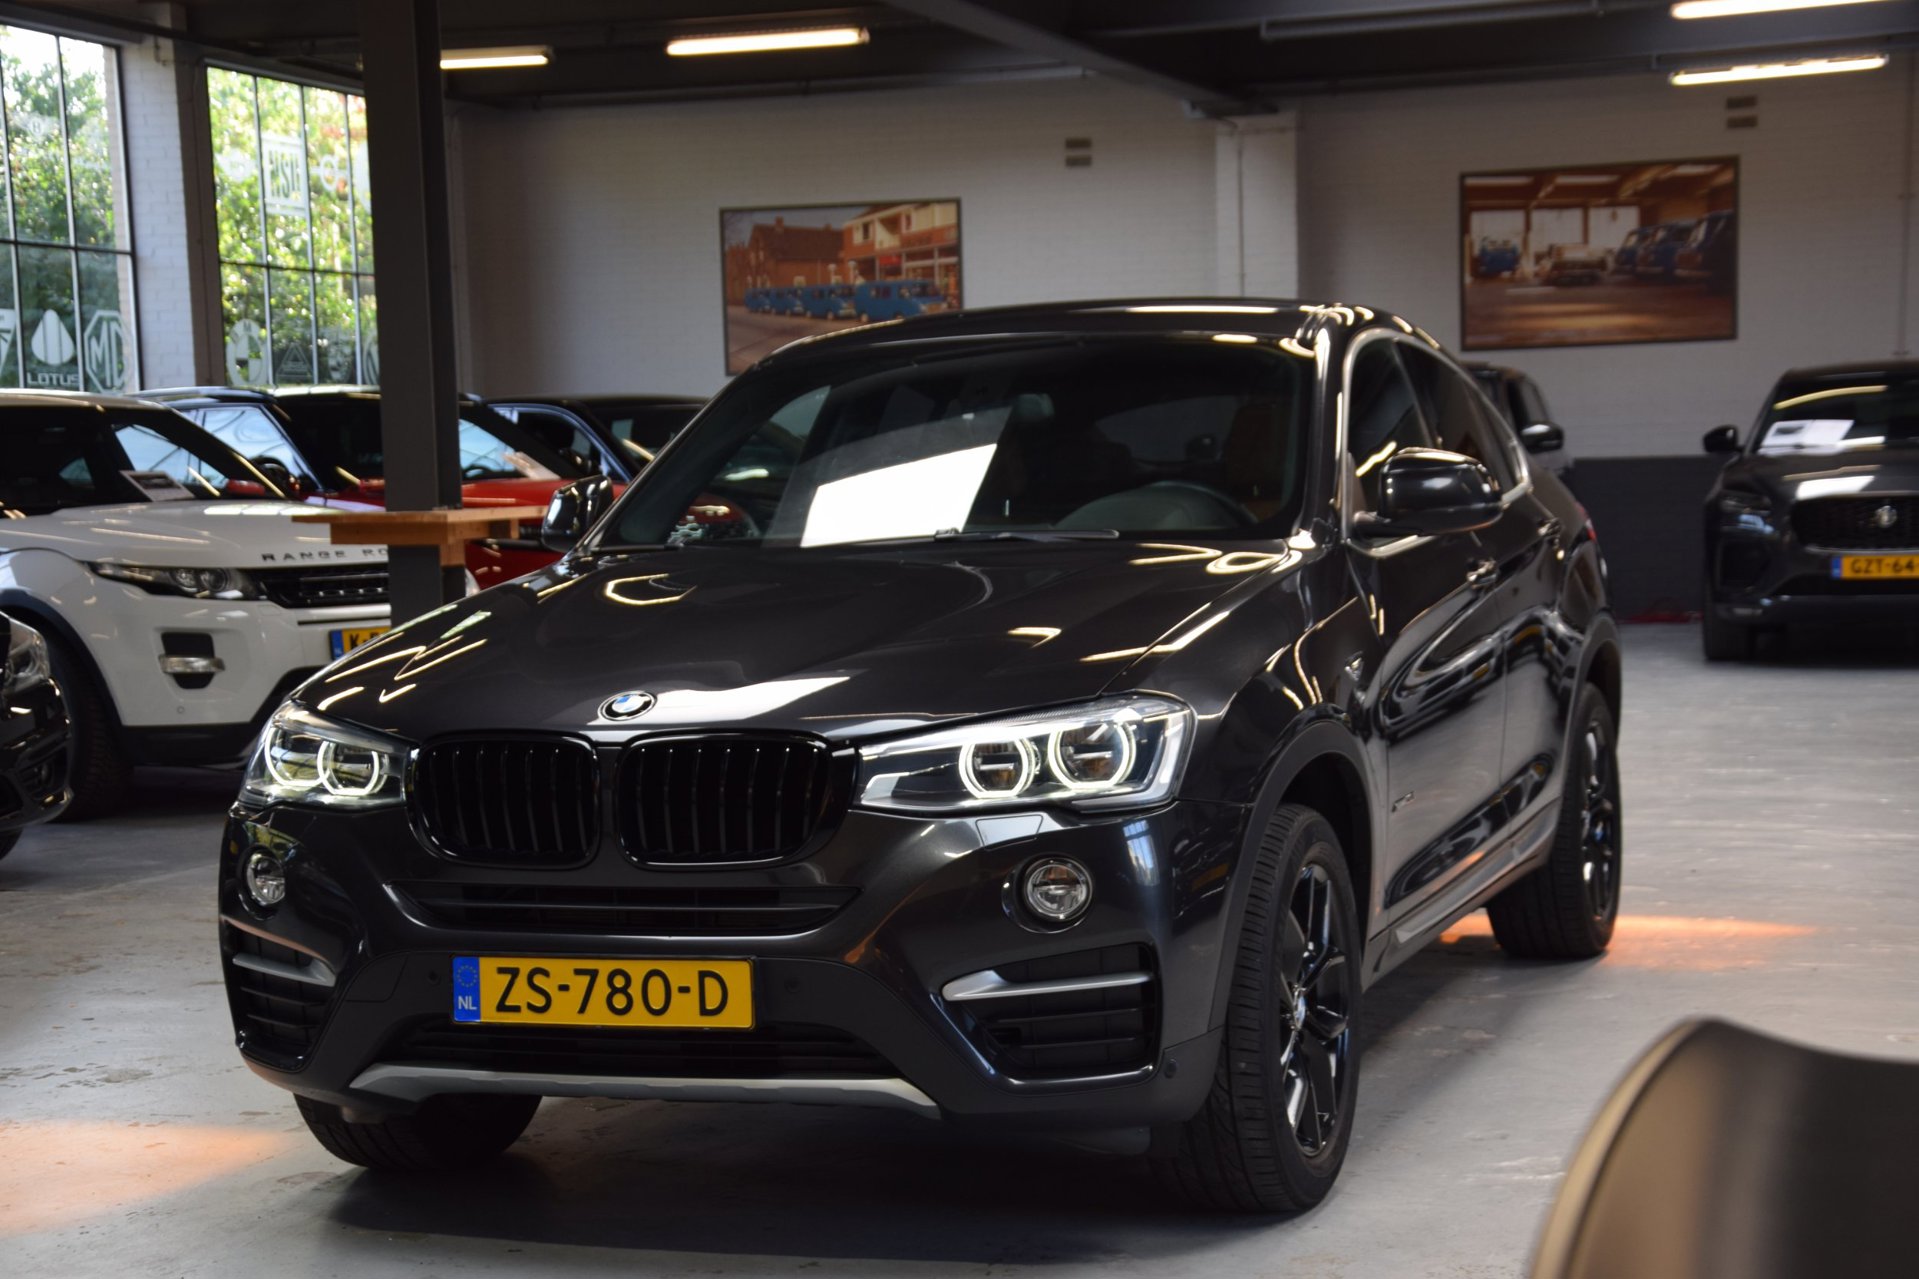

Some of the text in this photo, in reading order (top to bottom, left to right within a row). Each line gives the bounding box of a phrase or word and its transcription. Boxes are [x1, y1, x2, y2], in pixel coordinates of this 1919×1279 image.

[27, 372, 81, 385] LOTUS
[261, 549, 346, 562] RANGE
[495, 966, 729, 1017] ZS-780-D
[458, 996, 477, 1010] NL
